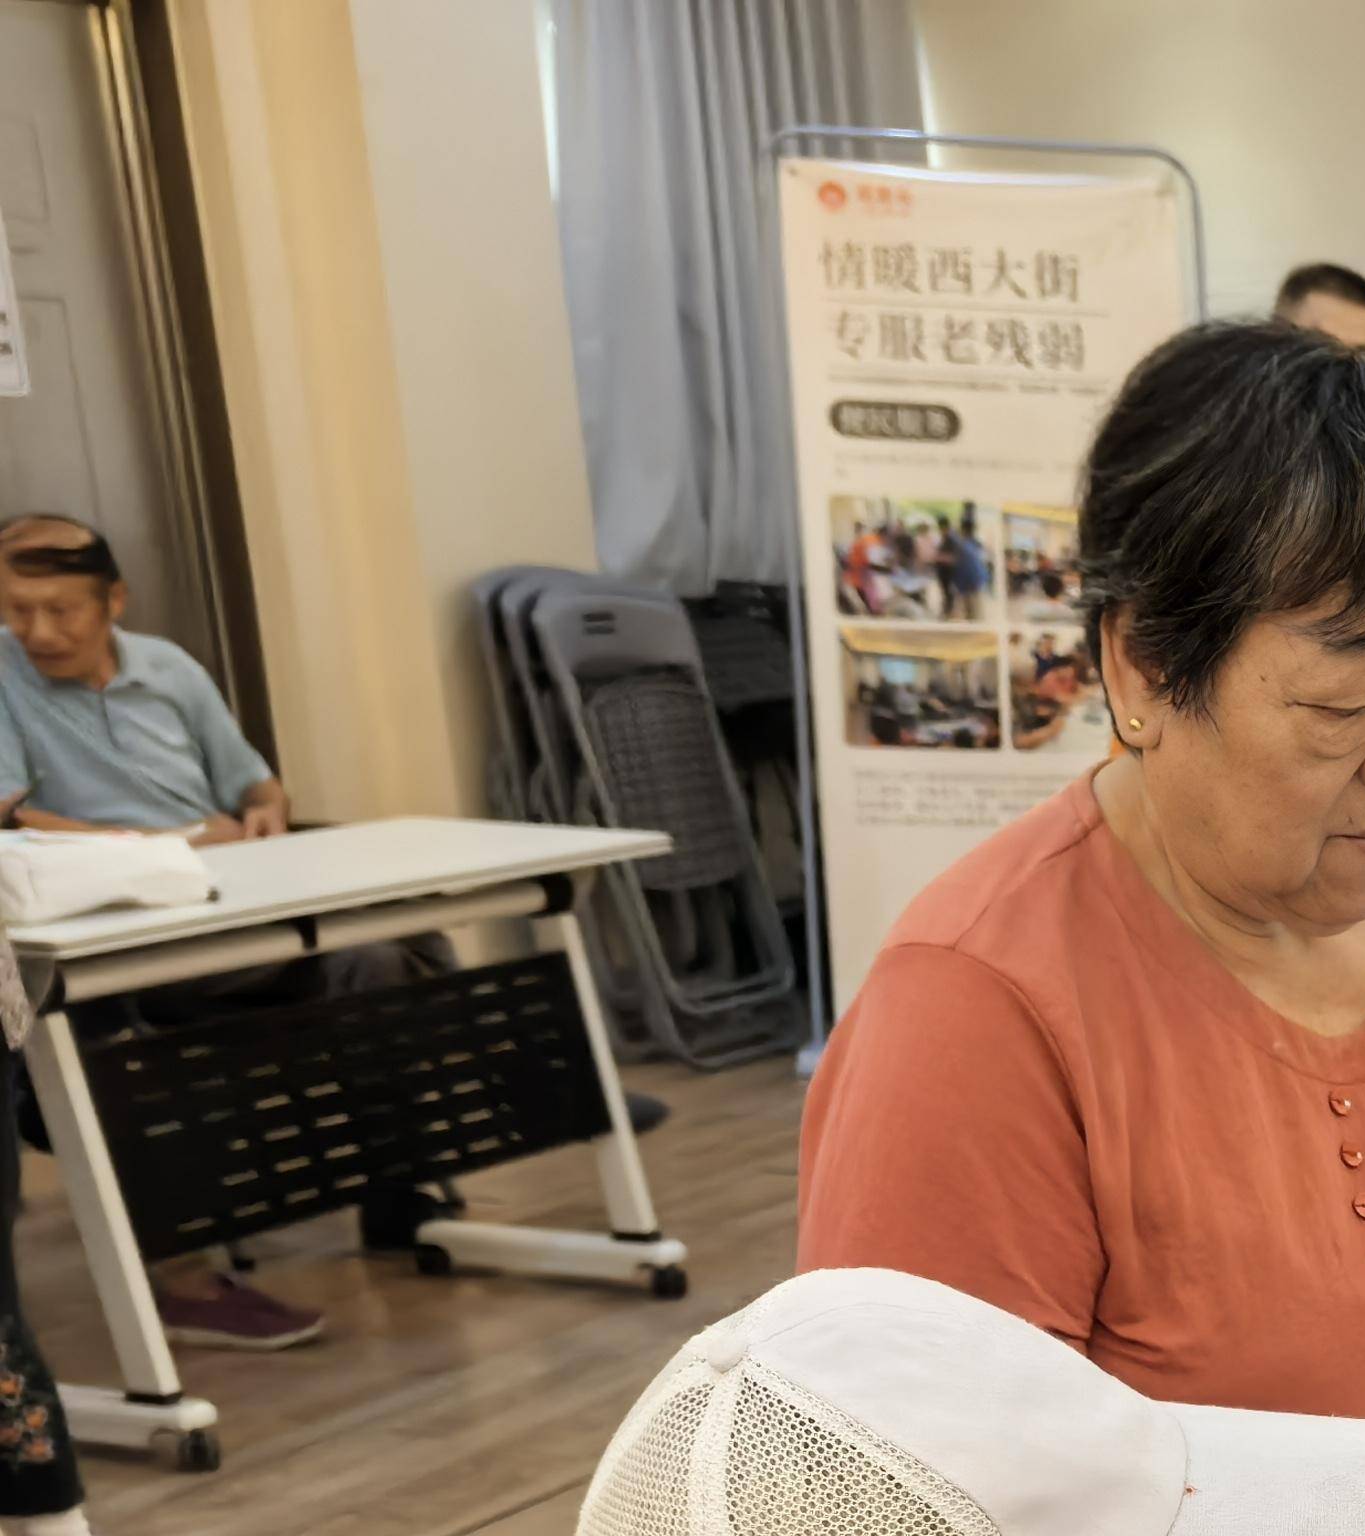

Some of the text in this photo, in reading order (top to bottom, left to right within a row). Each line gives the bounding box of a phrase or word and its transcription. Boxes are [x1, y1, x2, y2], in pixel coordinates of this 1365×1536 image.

[819, 239, 1079, 302] 情暖西大街
[829, 310, 1086, 372] 专服老残弱
